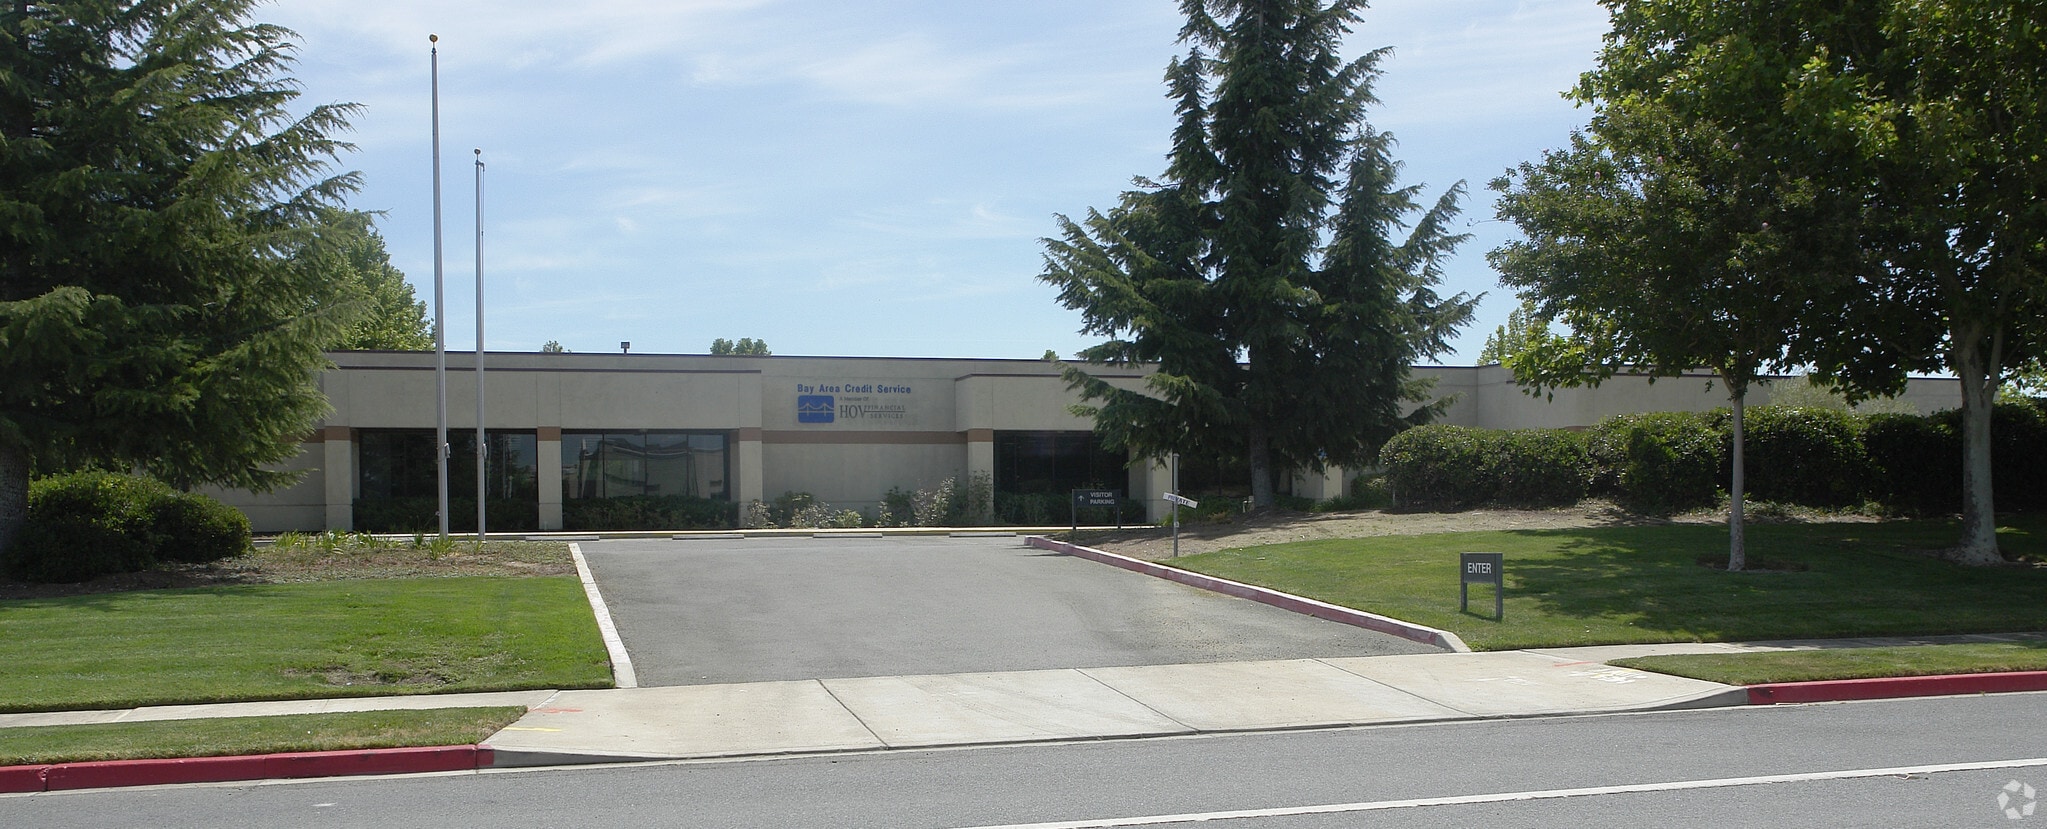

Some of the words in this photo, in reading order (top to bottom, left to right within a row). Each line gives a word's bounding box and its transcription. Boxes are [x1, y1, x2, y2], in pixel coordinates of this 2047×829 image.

[797, 384, 814, 394] Bay
[819, 384, 840, 393] Area
[845, 384, 872, 393] Credit
[877, 384, 911, 393] Service
[839, 404, 866, 419] HOV
[1467, 562, 1492, 574] ENTER
